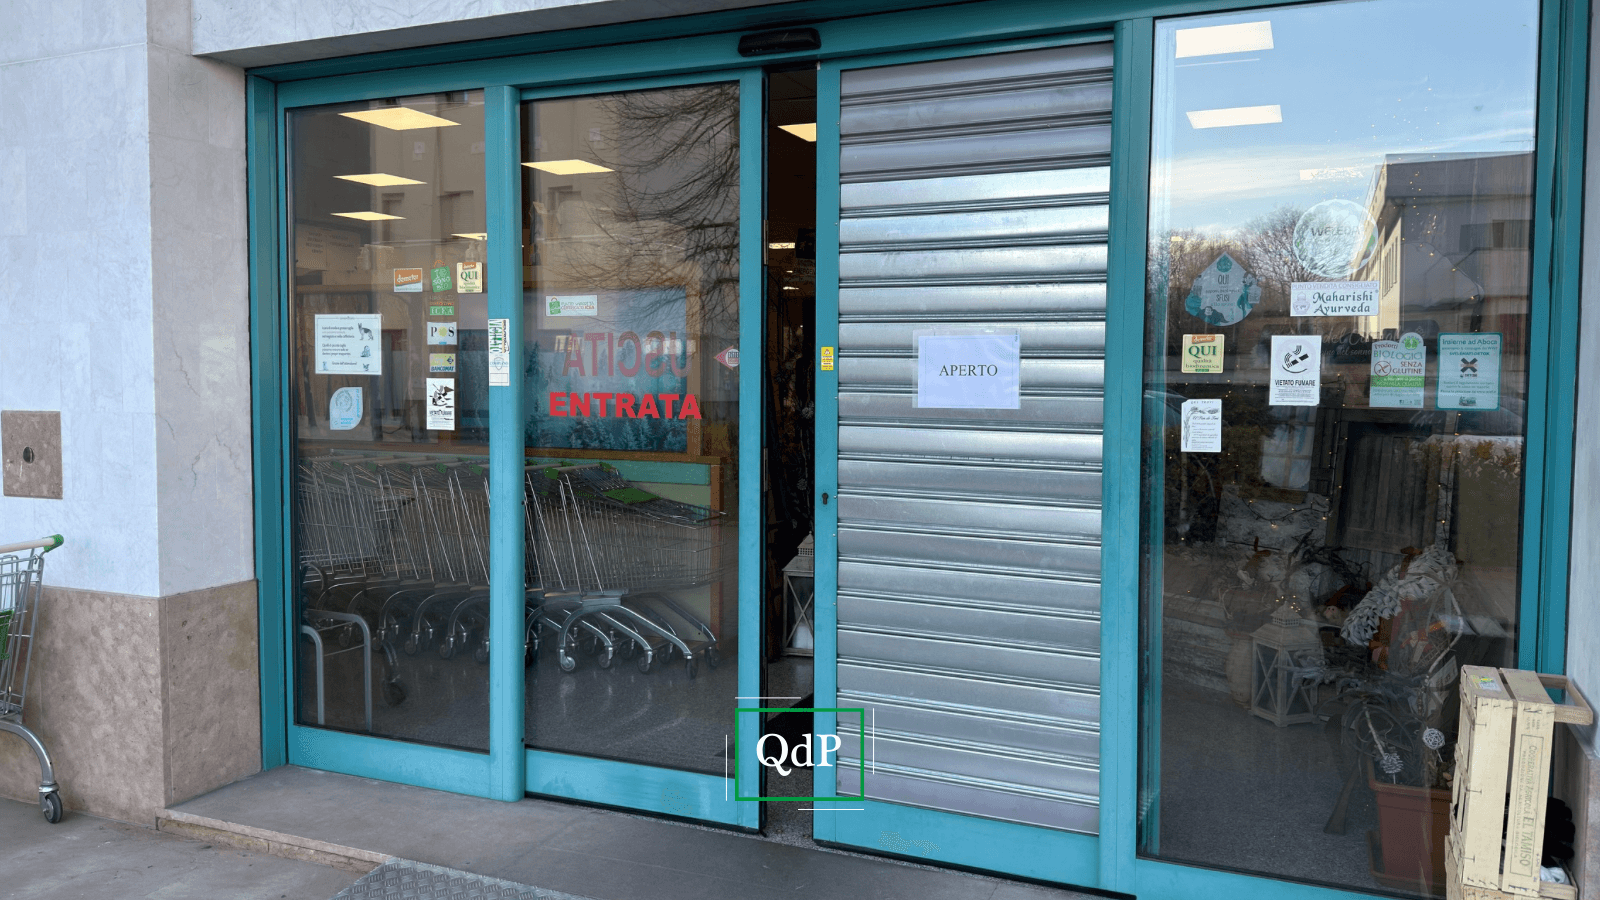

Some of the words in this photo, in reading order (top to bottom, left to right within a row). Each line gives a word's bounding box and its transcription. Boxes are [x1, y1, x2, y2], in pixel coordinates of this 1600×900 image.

[460, 271, 478, 281] QUI
[1313, 291, 1373, 303] Maharishi
[1314, 302, 1370, 316] Ayurveda
[1188, 346, 1217, 358] QUI
[1374, 350, 1422, 360] BIOLOGICI
[938, 364, 998, 376] APERTO
[550, 392, 702, 420] ENTRATA
[1522, 816, 1534, 828] EL
[1520, 832, 1534, 866] TAMISO
